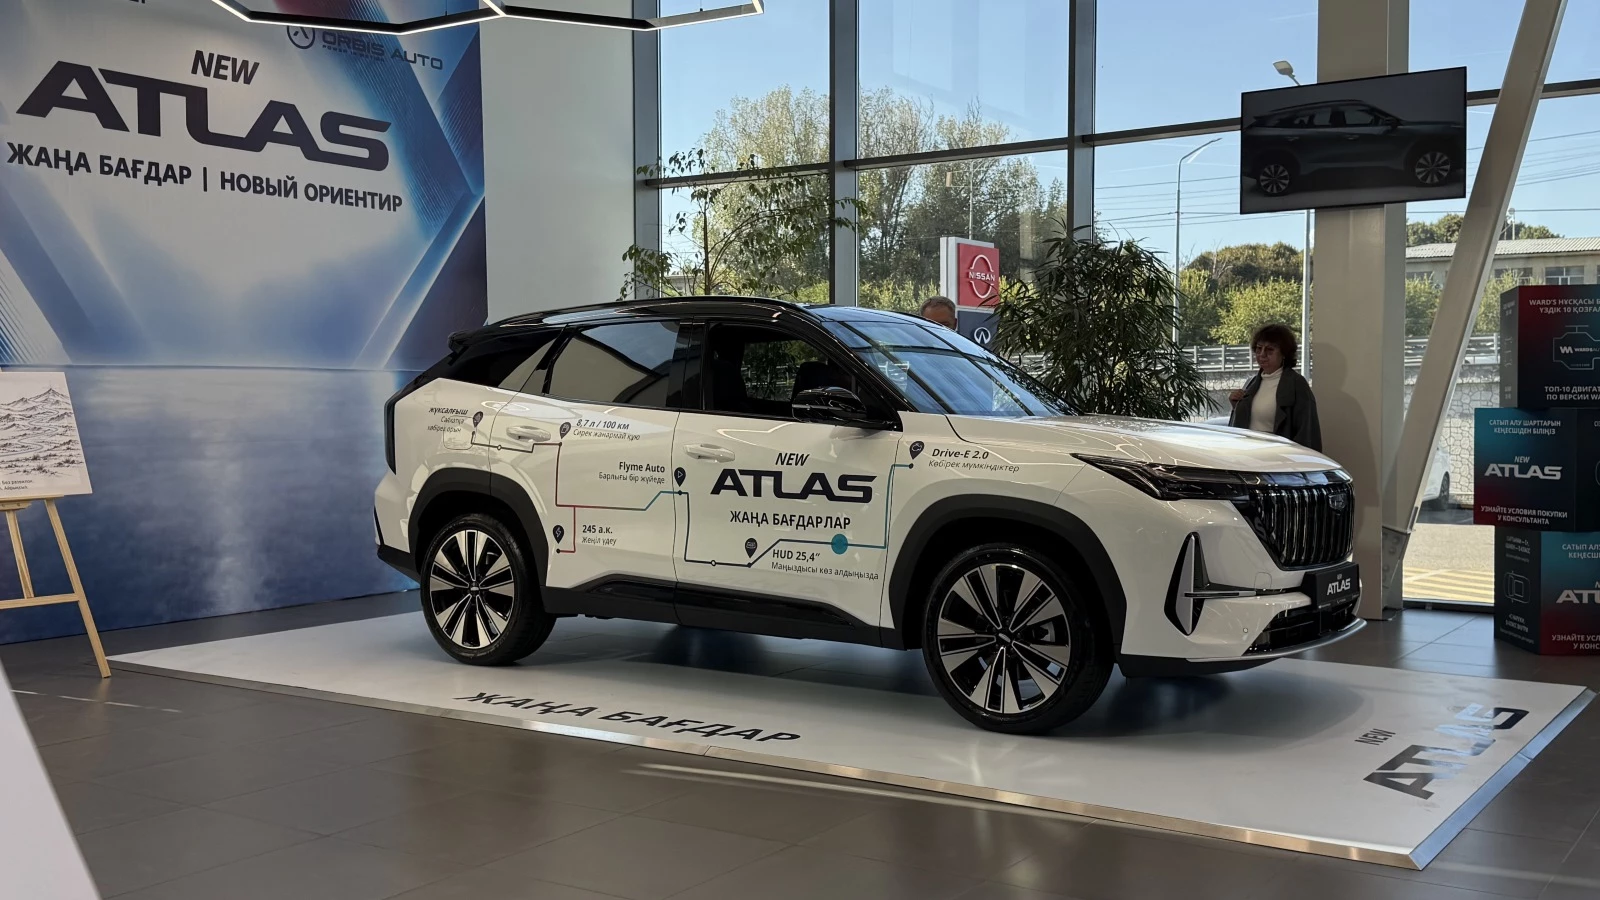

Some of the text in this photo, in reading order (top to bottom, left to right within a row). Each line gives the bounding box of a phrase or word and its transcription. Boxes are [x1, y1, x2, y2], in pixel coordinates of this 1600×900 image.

[322, 31, 443, 70] ORBIS AUTO
[191, 49, 260, 85] NEW
[16, 60, 391, 172] ATLAS
[7, 141, 91, 175] ЖАҢА
[99, 154, 192, 187] БАҒДАР
[220, 170, 298, 200] НОВЫЙ
[304, 183, 402, 213] ОРИЕНТИР
[968, 271, 995, 281] NISSAN
[576, 419, 589, 428] 8,7
[603, 420, 617, 429] 100
[775, 452, 810, 467] NEW
[932, 448, 989, 460] Drive-E 2.0
[619, 461, 665, 473] Flyme Auto
[1484, 463, 1563, 480] ATLAS
[710, 468, 877, 504] ATLAS
[1481, 505, 1568, 518] УЗНАЙТЕ УСЛОВИЯ ПОКУПКИ
[729, 510, 851, 530] ЖАҢА БАҒДАРЛАР
[1502, 515, 1550, 525] КОНСУЛЬТАНТА
[582, 524, 597, 534] 245
[772, 549, 794, 560] HUD
[771, 561, 818, 574] Маңыздысы
[819, 567, 833, 575] көз
[1326, 578, 1351, 596] ATLAS
[1551, 633, 1586, 642] УЗНАЙТЕ
[452, 692, 801, 742] ЖАҢА БАҒДАР
[1354, 728, 1396, 746] NEW
[1363, 703, 1530, 800] ATLAS
